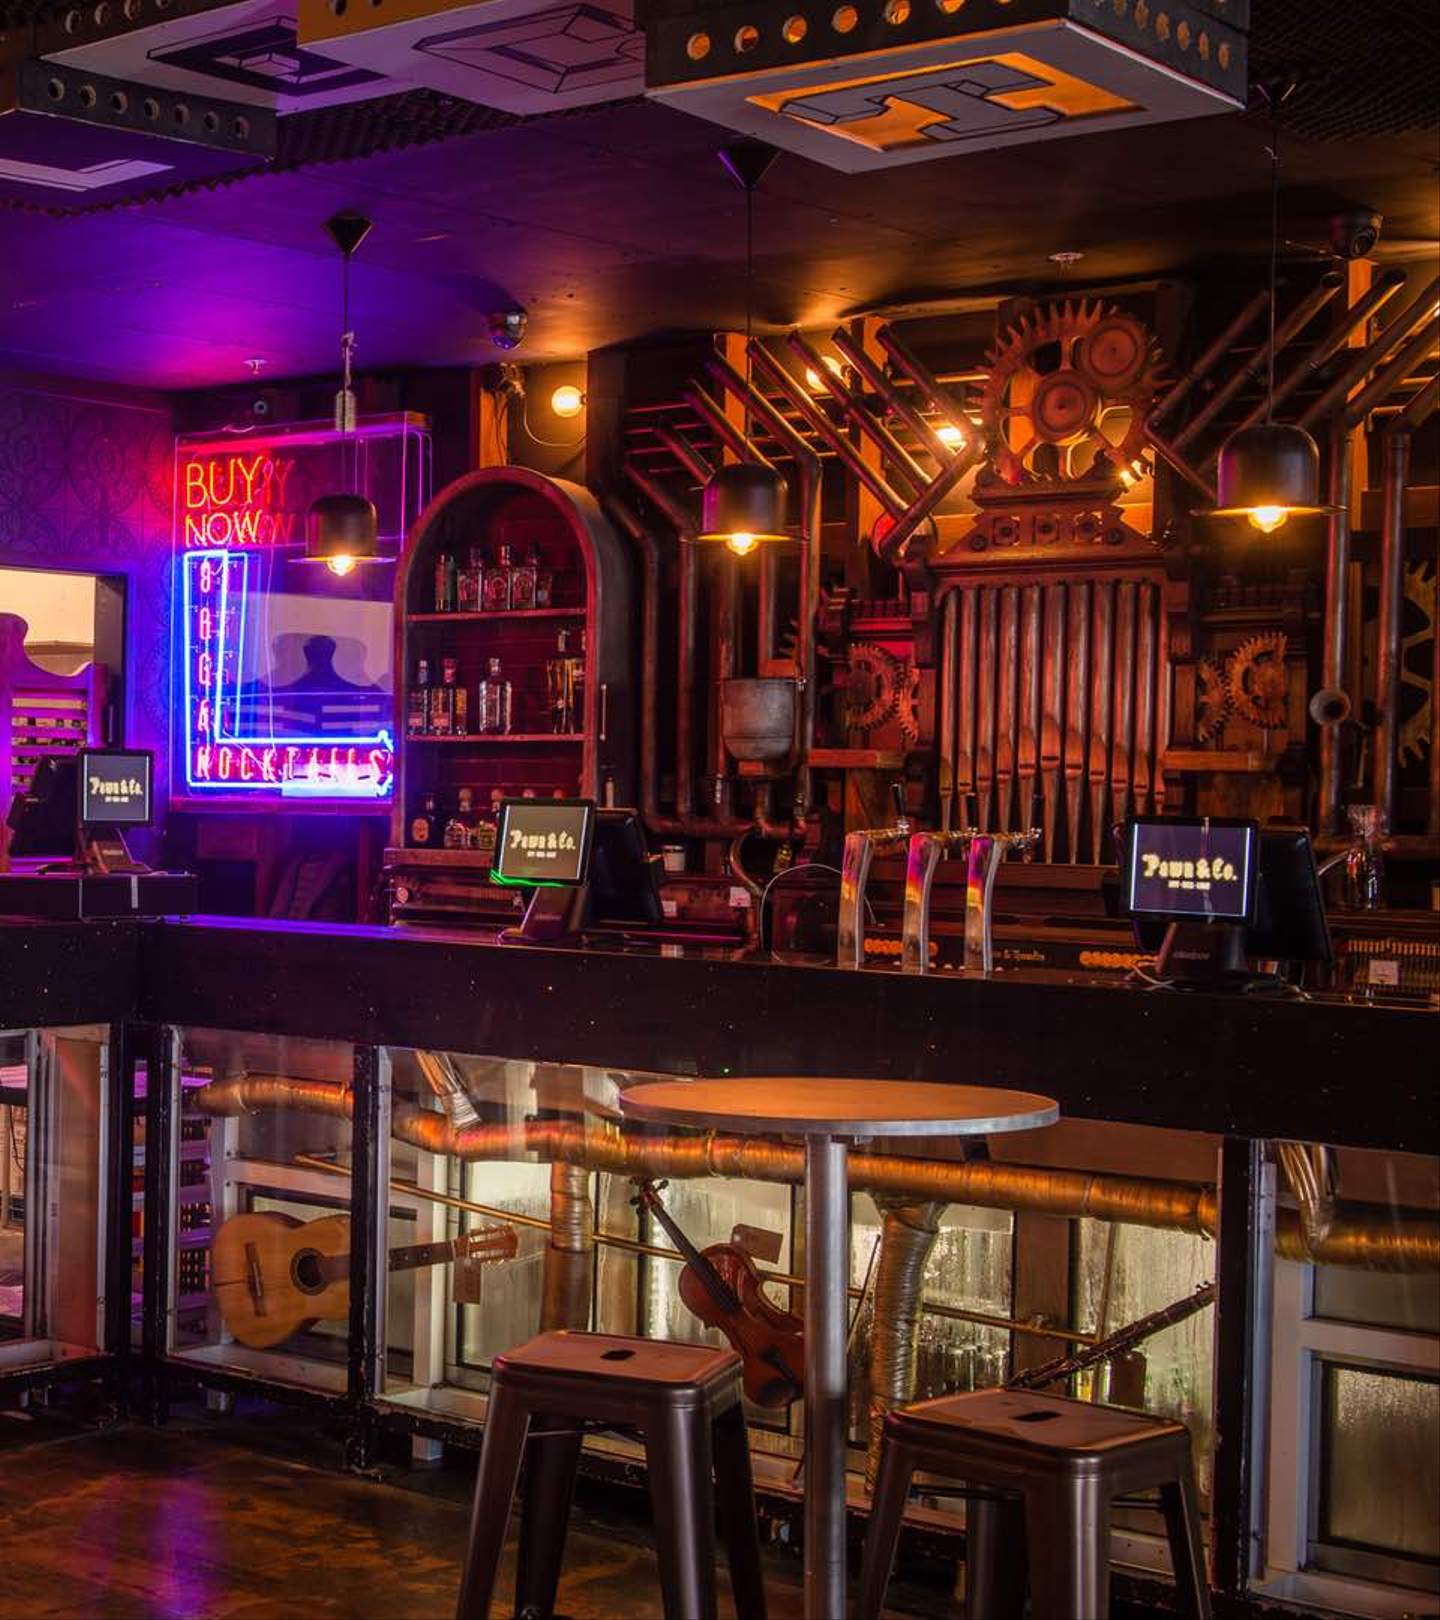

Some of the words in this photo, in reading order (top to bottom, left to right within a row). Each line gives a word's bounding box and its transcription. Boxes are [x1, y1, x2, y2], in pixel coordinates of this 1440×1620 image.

[186, 456, 263, 508] BUY
[185, 510, 262, 548] NOW
[1142, 854, 1194, 879] Pawn
